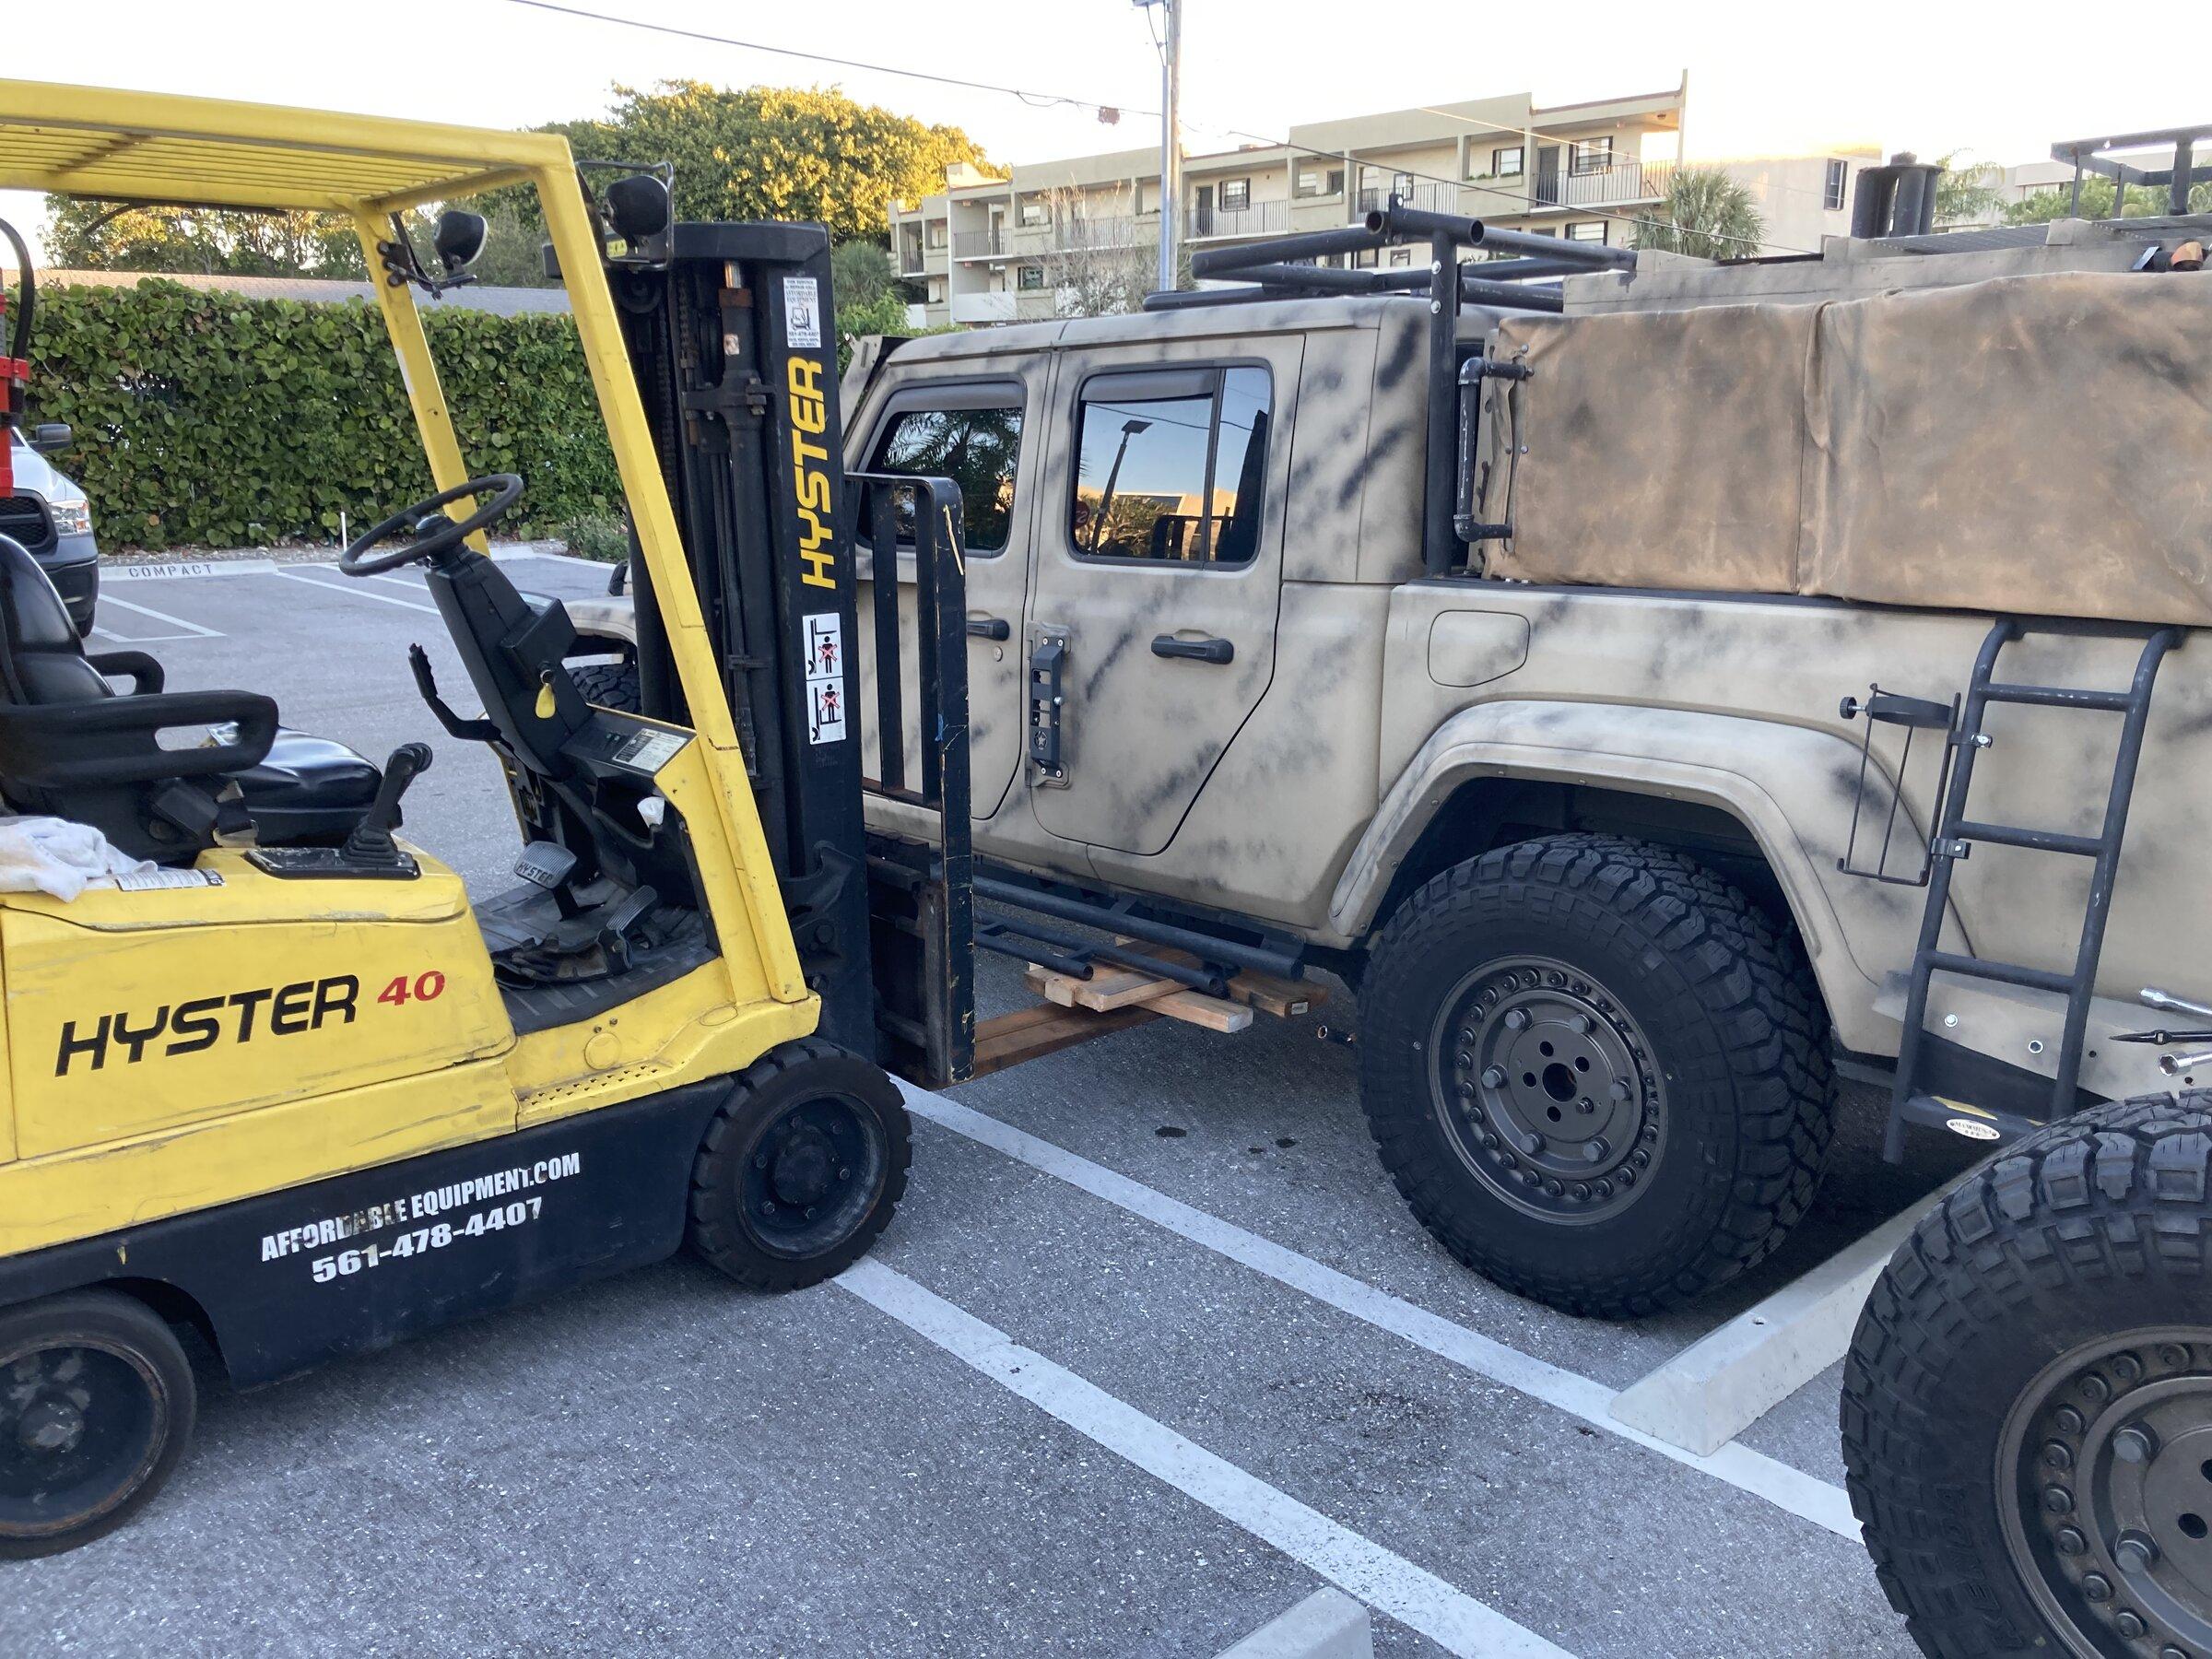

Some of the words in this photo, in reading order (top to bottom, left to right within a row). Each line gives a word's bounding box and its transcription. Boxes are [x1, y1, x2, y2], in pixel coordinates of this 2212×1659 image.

[788, 356, 836, 590] HYSTER
[128, 563, 212, 578] COMPACT
[516, 861, 554, 886] HYSTER
[54, 973, 360, 1077] HYSTER
[377, 971, 446, 1006] 40
[261, 1199, 406, 1262] AFFORDABLE
[411, 1152, 581, 1218] EQUIPMENT.COM
[312, 1196, 543, 1283] 561-478-4407
